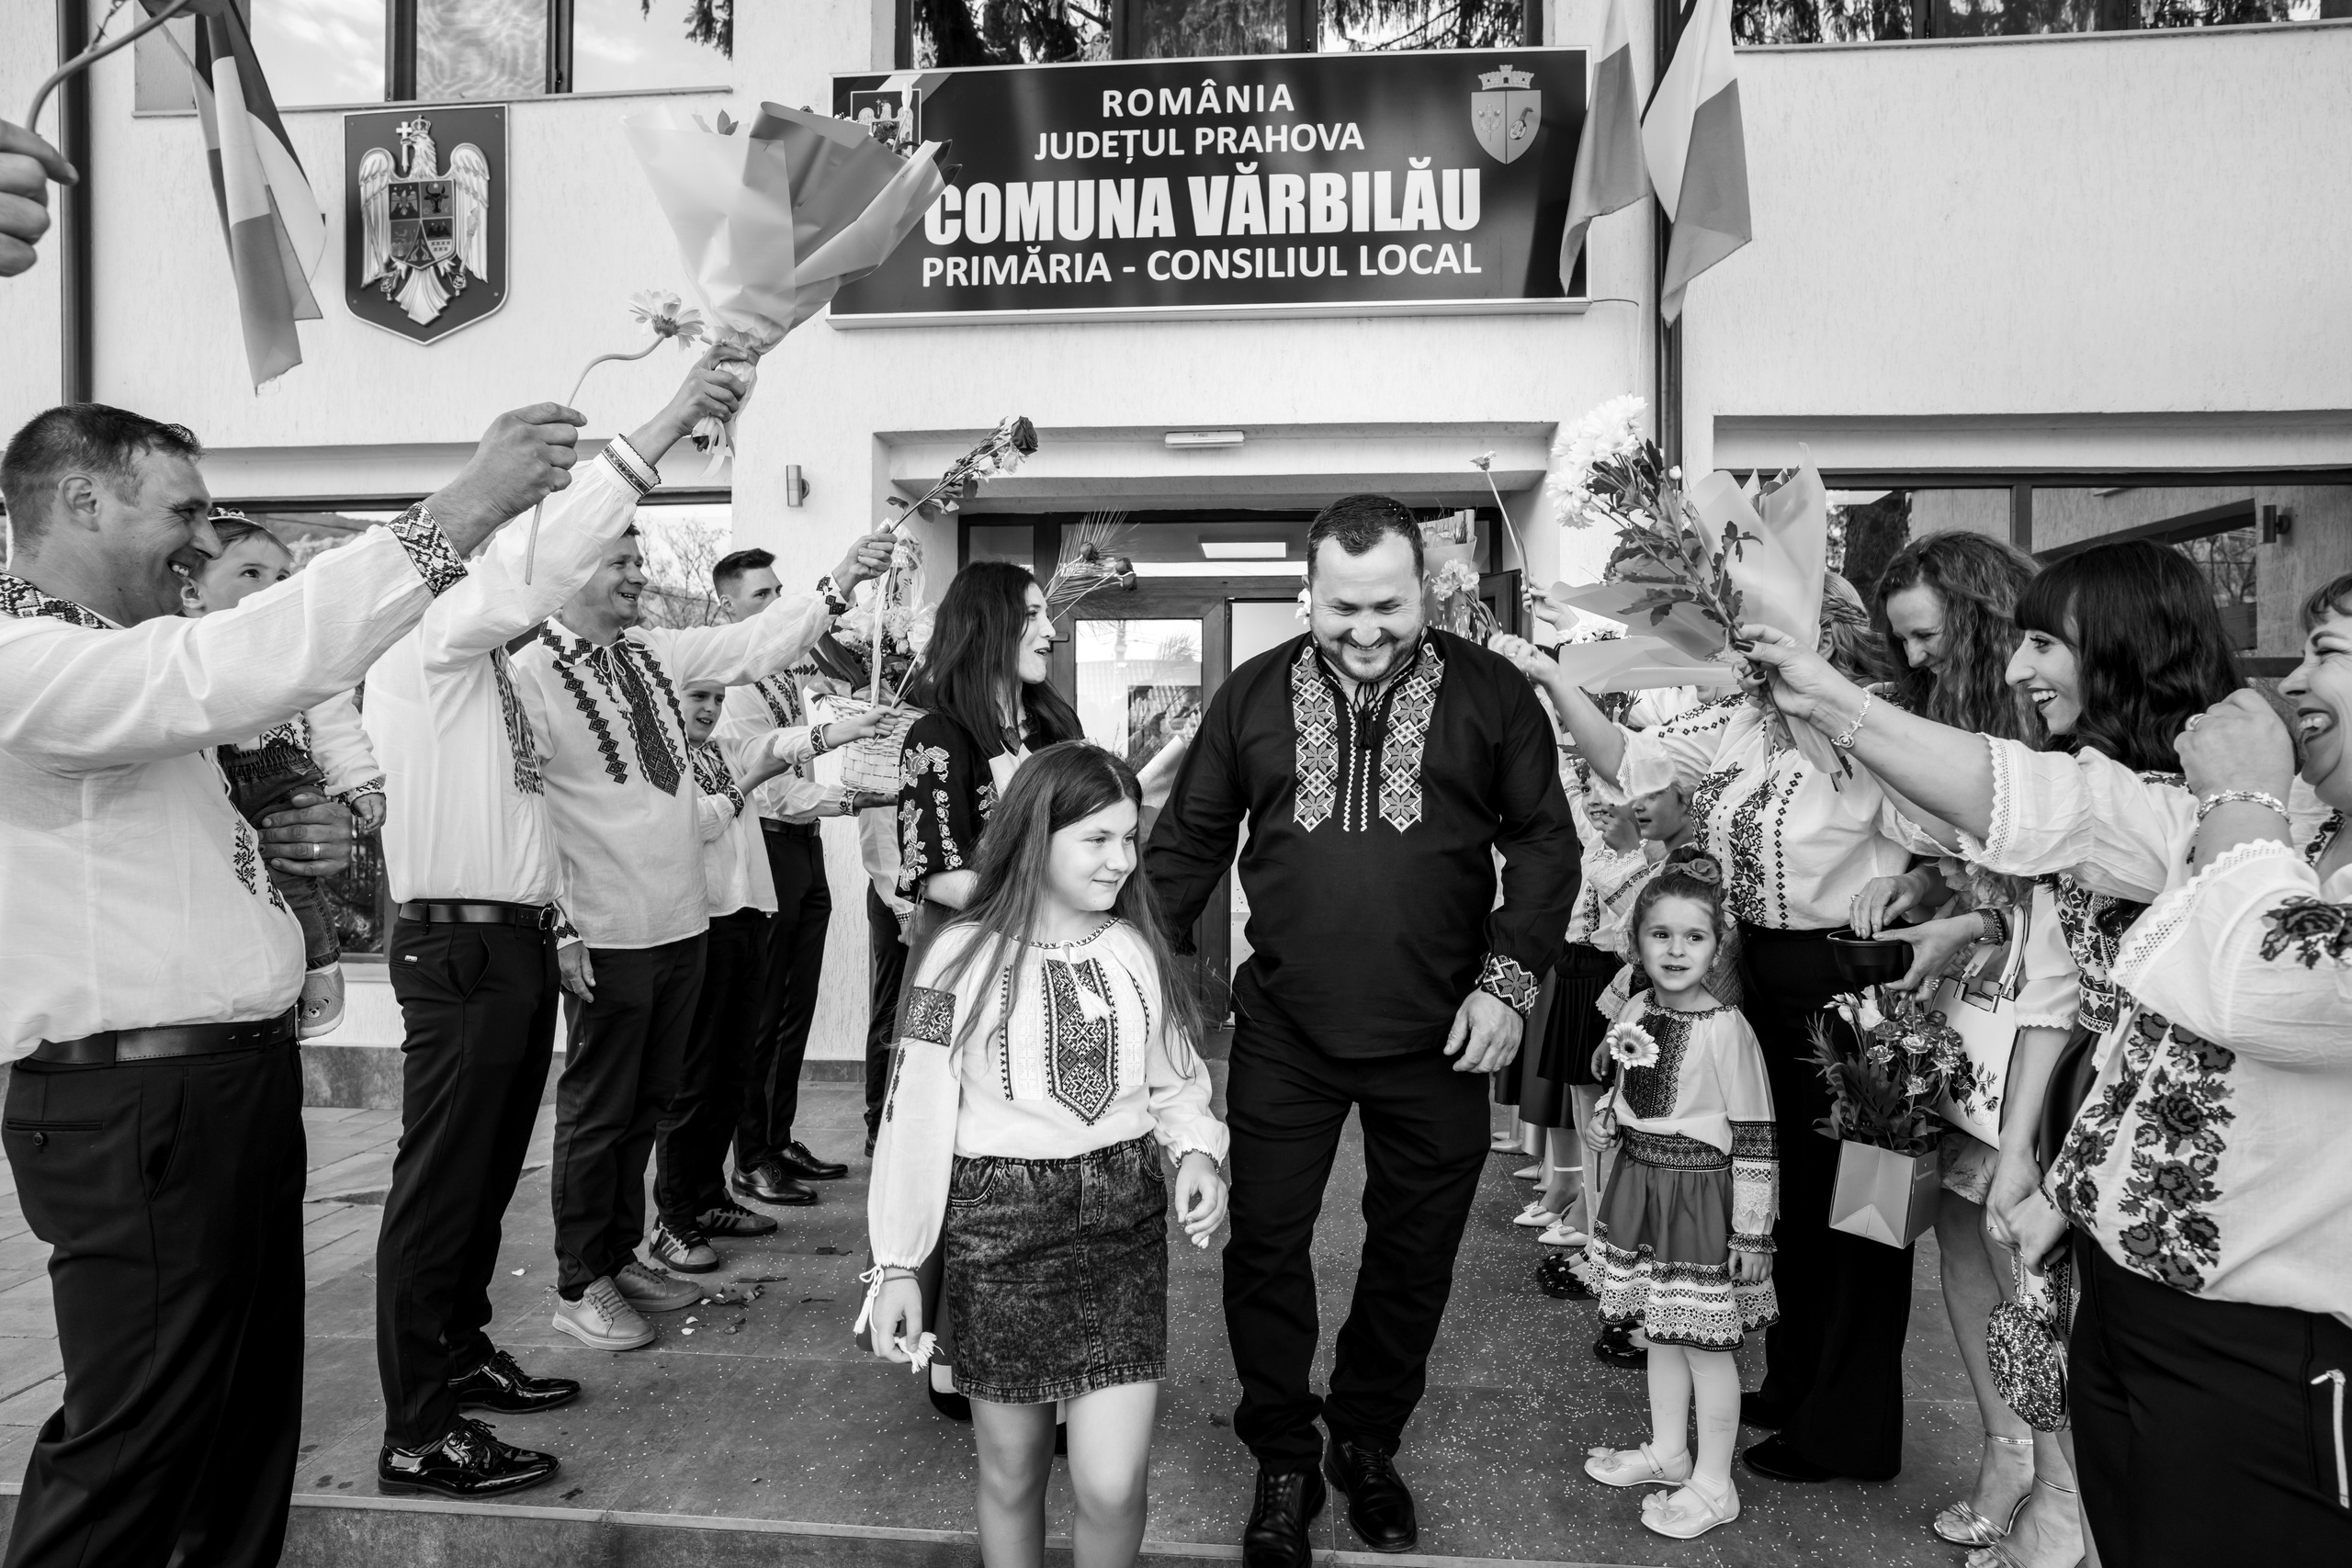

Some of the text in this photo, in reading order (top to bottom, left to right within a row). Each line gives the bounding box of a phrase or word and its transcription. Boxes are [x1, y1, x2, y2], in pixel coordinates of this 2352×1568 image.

[1102, 78, 1295, 118] ROMÂNIA
[1034, 122, 1366, 164] JUDEȚUL PRAHOVA
[924, 155, 1481, 246] COMUNA VĂRBILĂU
[922, 245, 1113, 288] PRIMĂRIA
[1147, 246, 1349, 282] CONSILIUL
[1360, 242, 1483, 276] LOCAL
